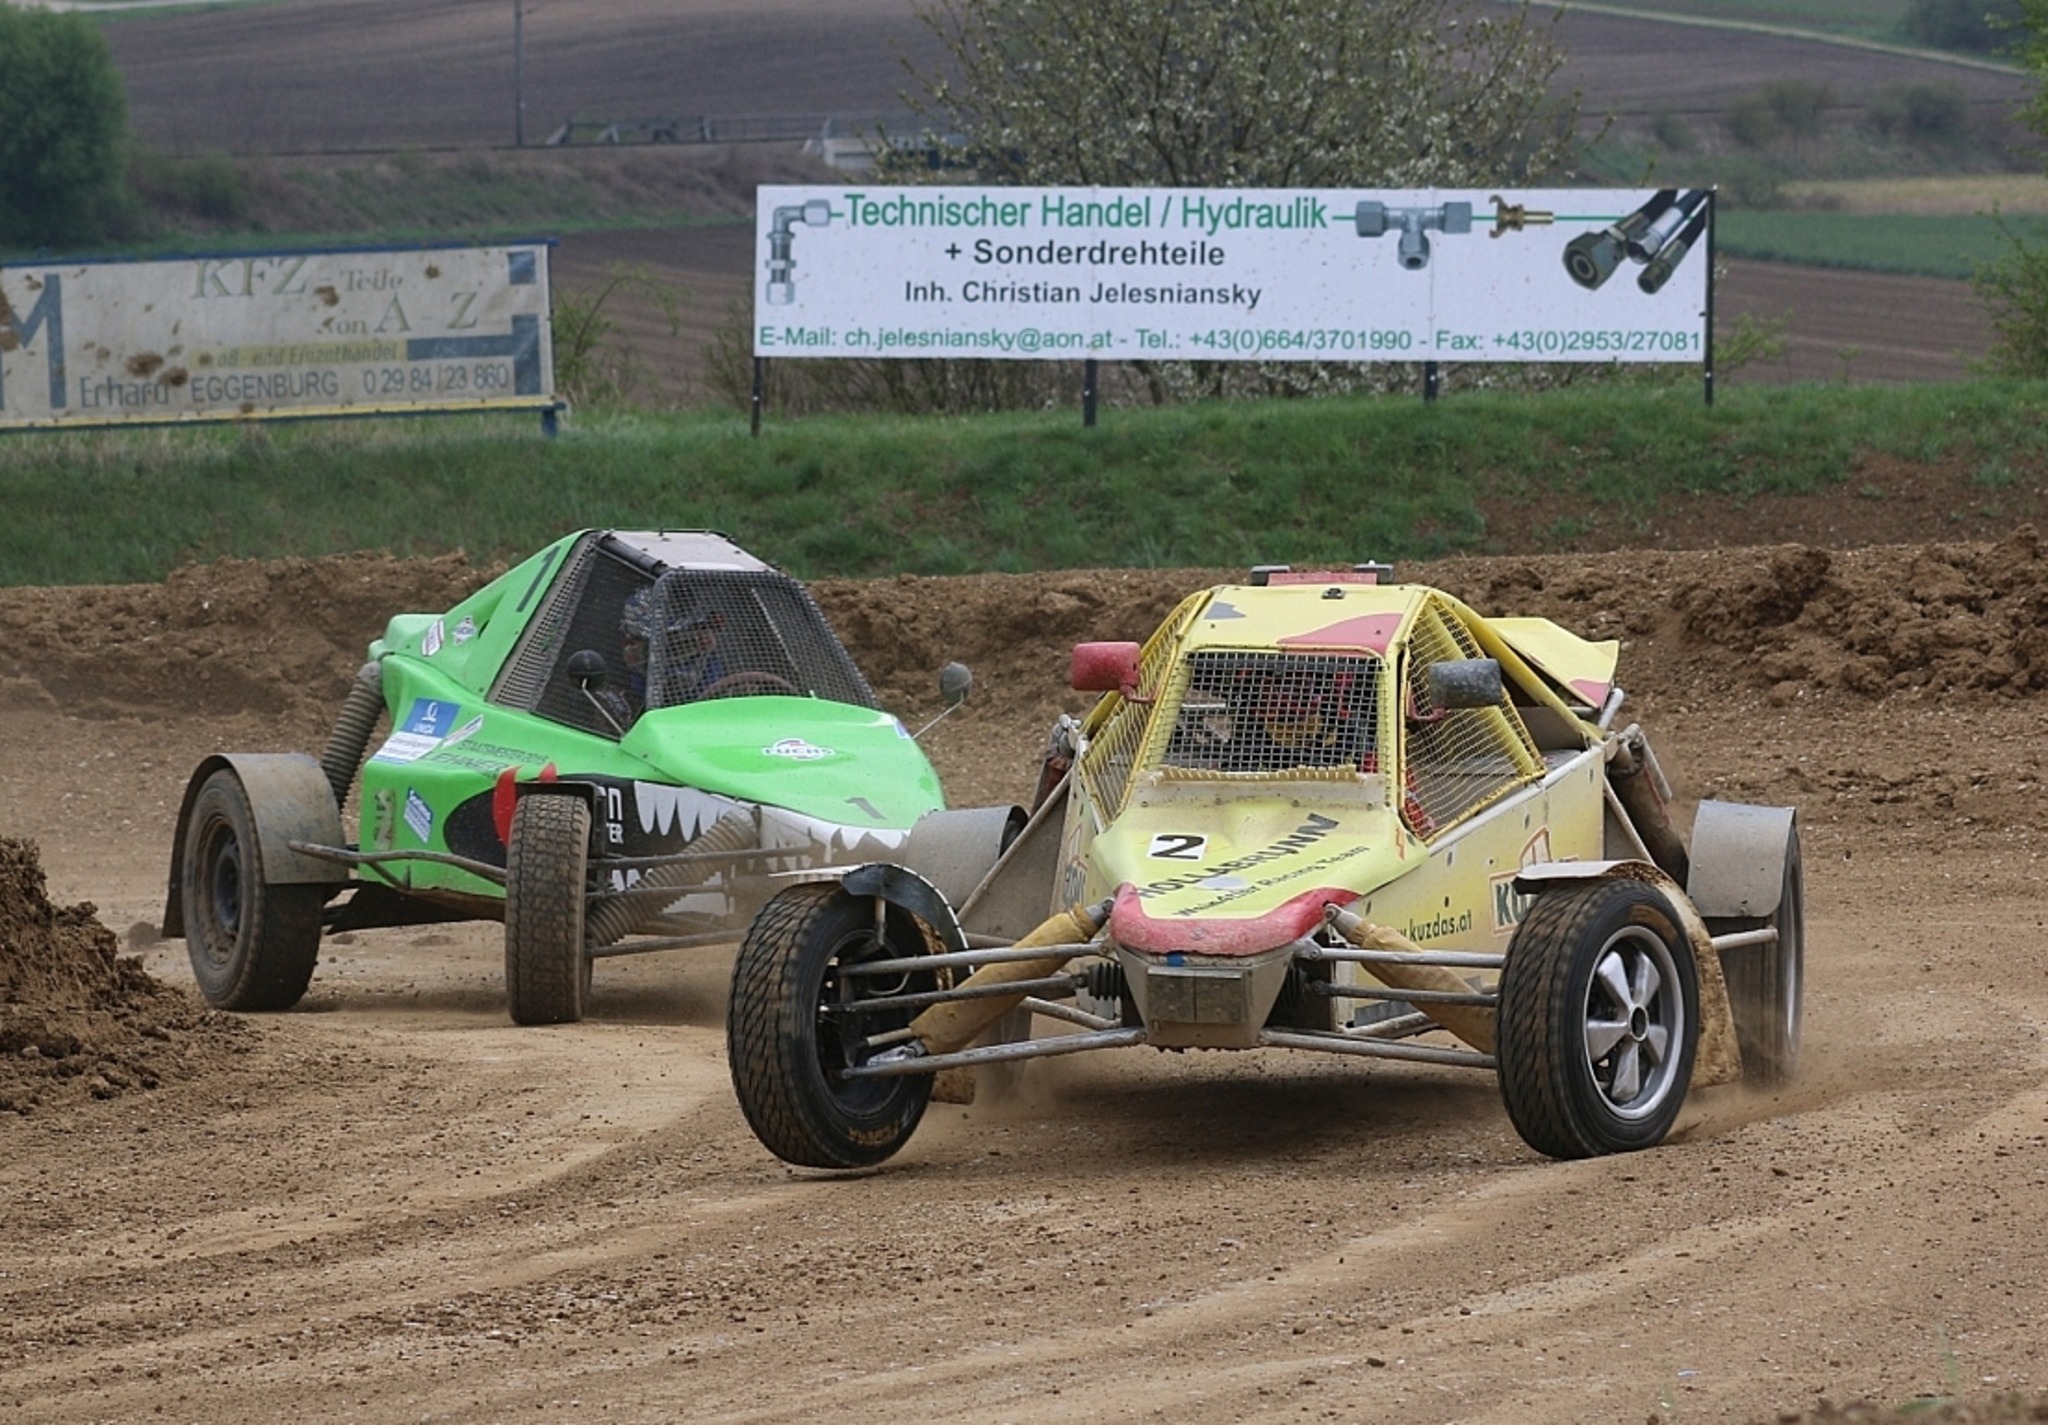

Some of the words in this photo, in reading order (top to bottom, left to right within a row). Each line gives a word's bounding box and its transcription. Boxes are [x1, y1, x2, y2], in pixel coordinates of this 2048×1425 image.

[844, 194, 1030, 226] Technischer
[1041, 195, 1150, 227] Handel
[1160, 196, 1172, 228] /
[1182, 197, 1328, 236] Hydraulik
[944, 243, 962, 261] +
[974, 239, 1226, 266] Sonderdrehteile
[193, 257, 307, 298] KFZ
[340, 268, 404, 292] Teile
[905, 282, 952, 303] Inh.
[962, 282, 1080, 303] Christian
[1089, 284, 1262, 310] Jelesniansky
[374, 292, 412, 332] A
[447, 292, 478, 330] Z
[759, 327, 837, 347] E-Mail:
[845, 328, 1112, 352] ch.jelesniansky@aon.at
[1135, 329, 1181, 350] Tel.:
[1189, 330, 1411, 352] +43(0)664/3701990
[1436, 331, 1484, 351] Fax:
[1492, 332, 1700, 354] +43(0)2953/27081
[191, 371, 339, 403] EGGENBURG
[1151, 834, 1205, 860] 2
